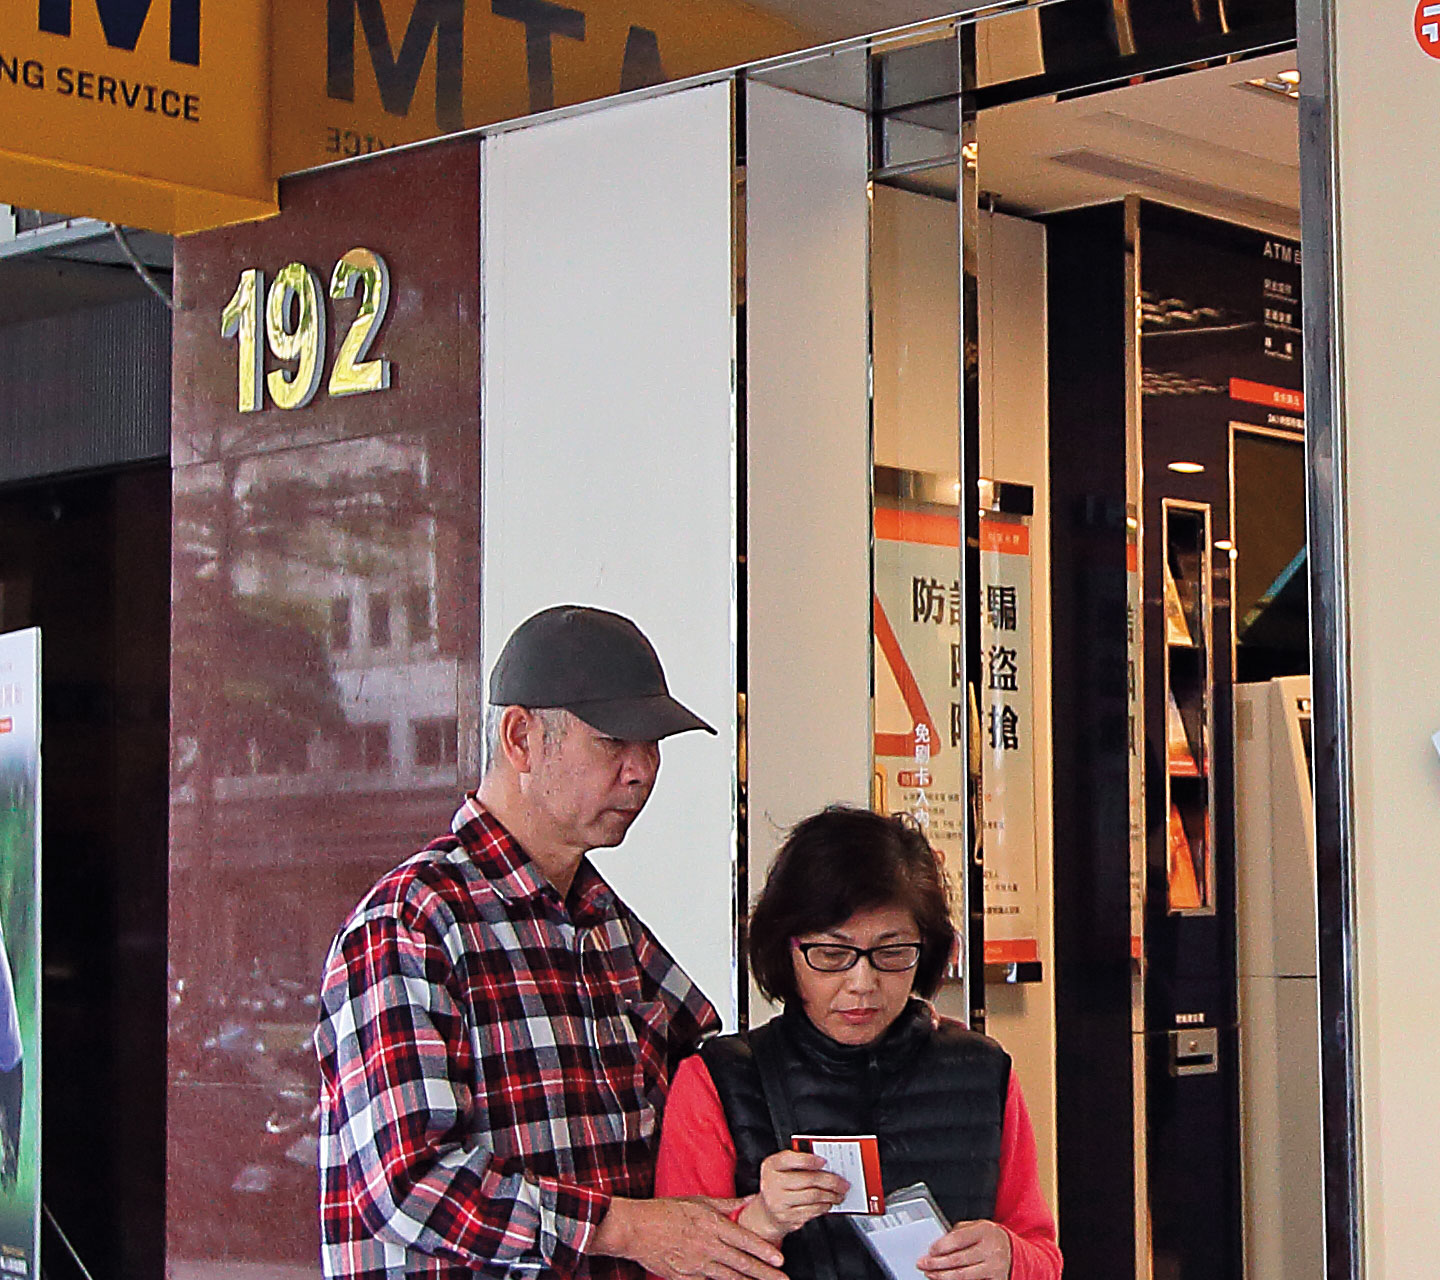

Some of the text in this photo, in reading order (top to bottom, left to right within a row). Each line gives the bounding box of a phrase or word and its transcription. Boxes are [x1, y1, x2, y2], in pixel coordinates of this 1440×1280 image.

[56, 67, 201, 123] SERVICE
[1263, 240, 1292, 264] ATM
[221, 247, 389, 412] 192
